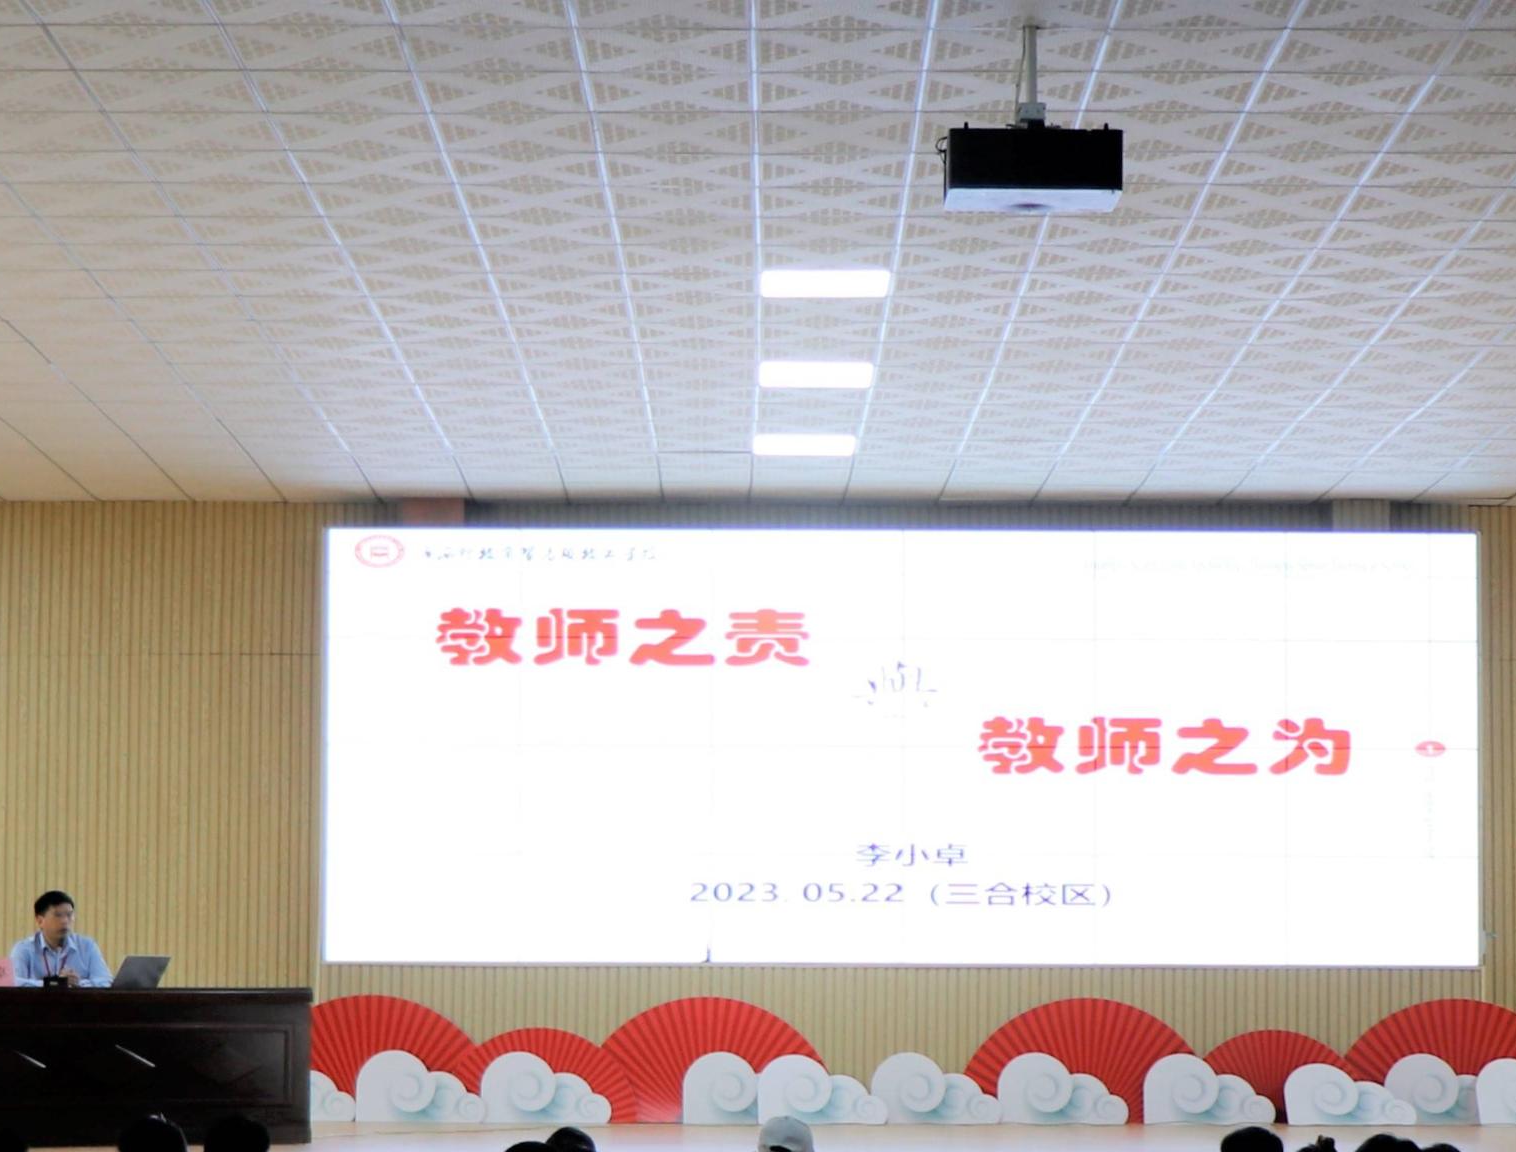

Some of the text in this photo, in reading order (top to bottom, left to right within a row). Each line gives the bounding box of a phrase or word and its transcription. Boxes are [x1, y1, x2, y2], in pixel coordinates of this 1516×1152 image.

[436, 607, 808, 666] 教师之责
[978, 716, 1351, 776] 教师之为
[856, 843, 968, 867] 李小卓
